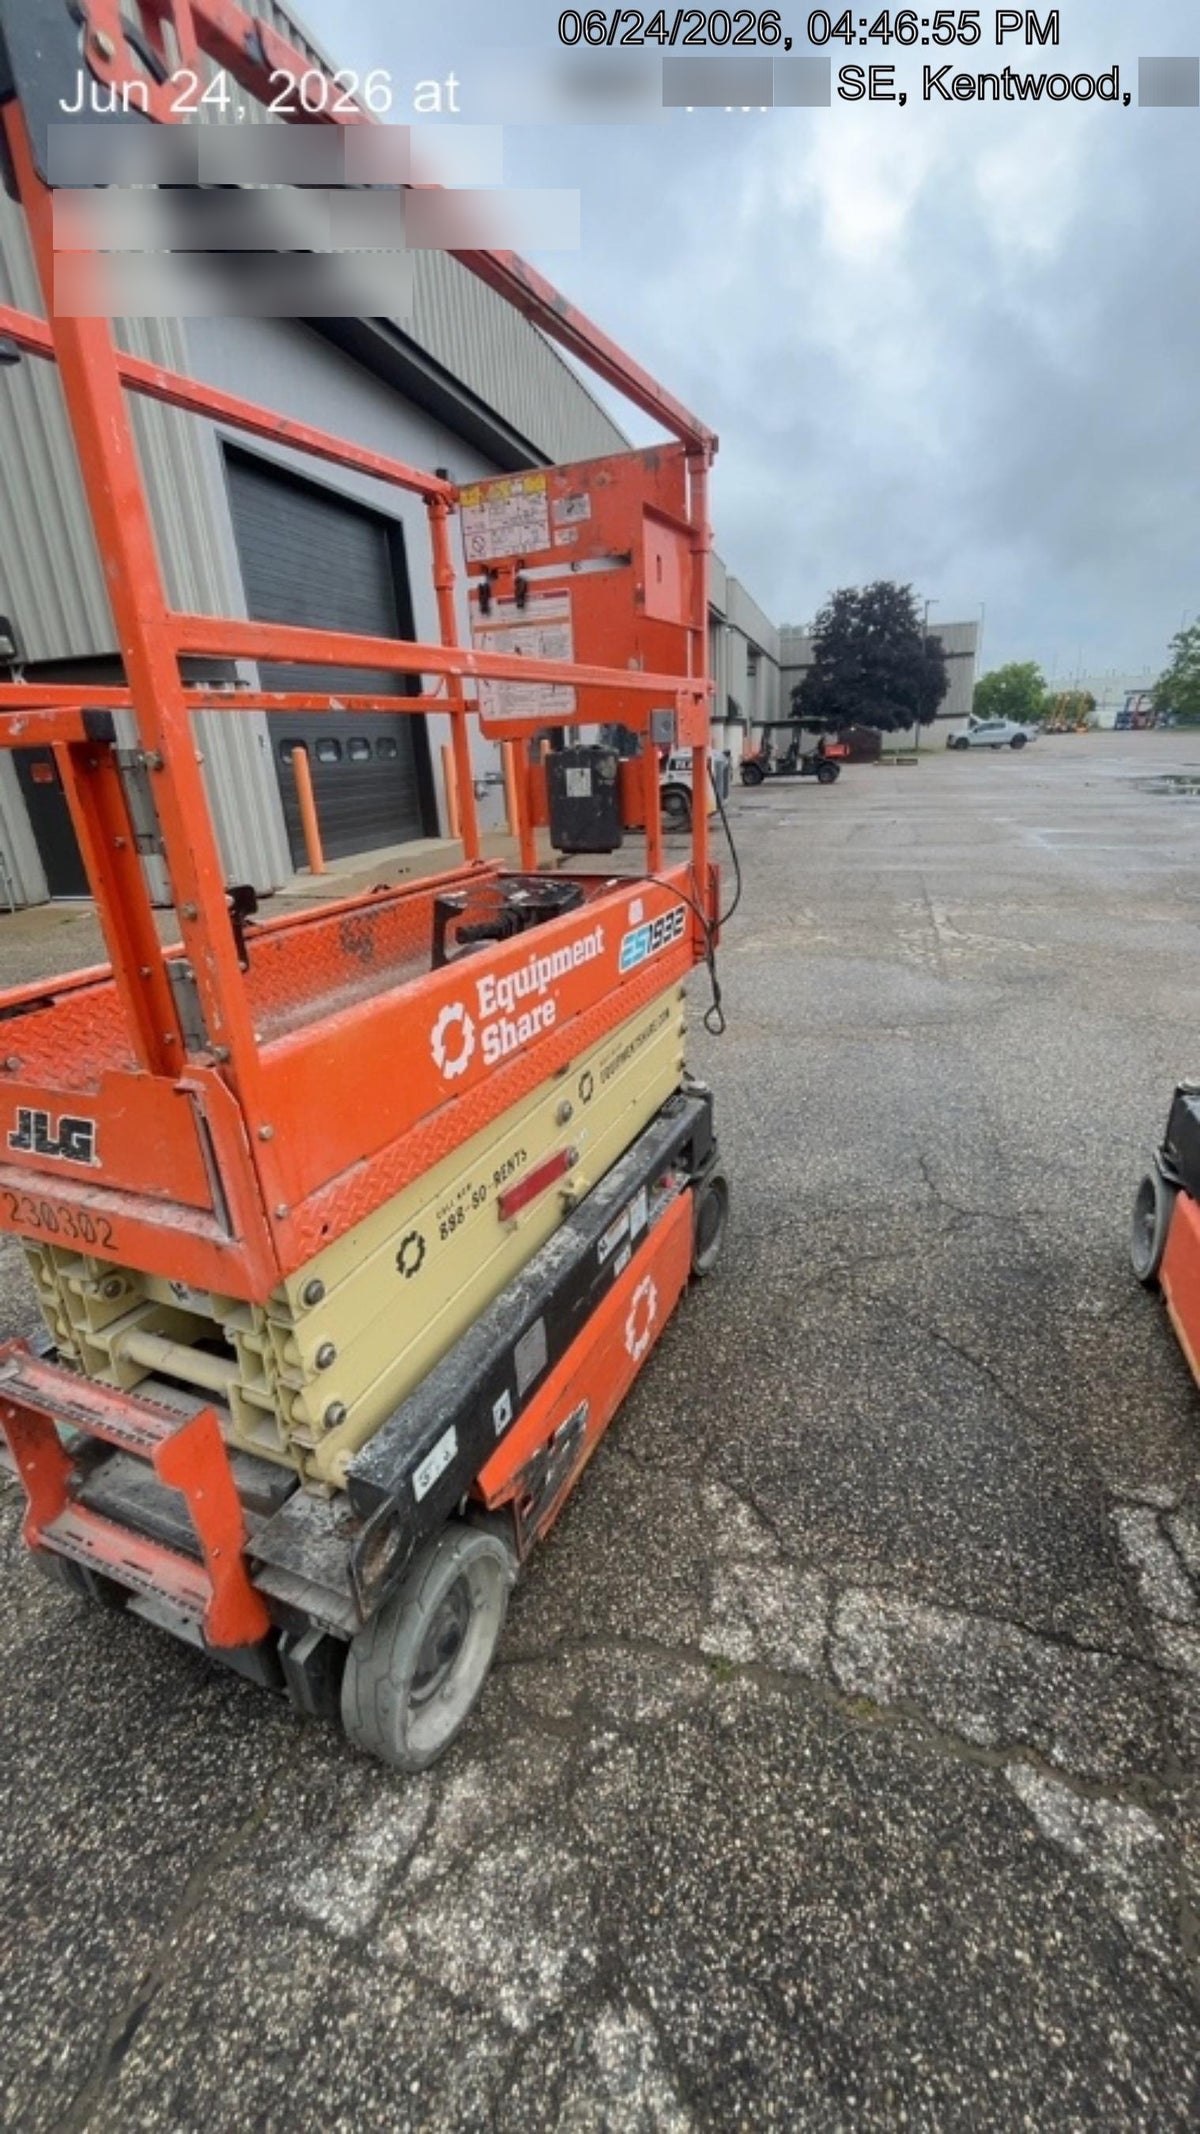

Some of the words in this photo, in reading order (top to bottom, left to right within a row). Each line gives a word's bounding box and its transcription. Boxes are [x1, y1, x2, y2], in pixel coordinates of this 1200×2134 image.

[475, 925, 605, 1019] Equipment
[480, 999, 556, 1066] Share
[7, 1106, 98, 1166] JLG
[3, 1191, 119, 1251] 230302
